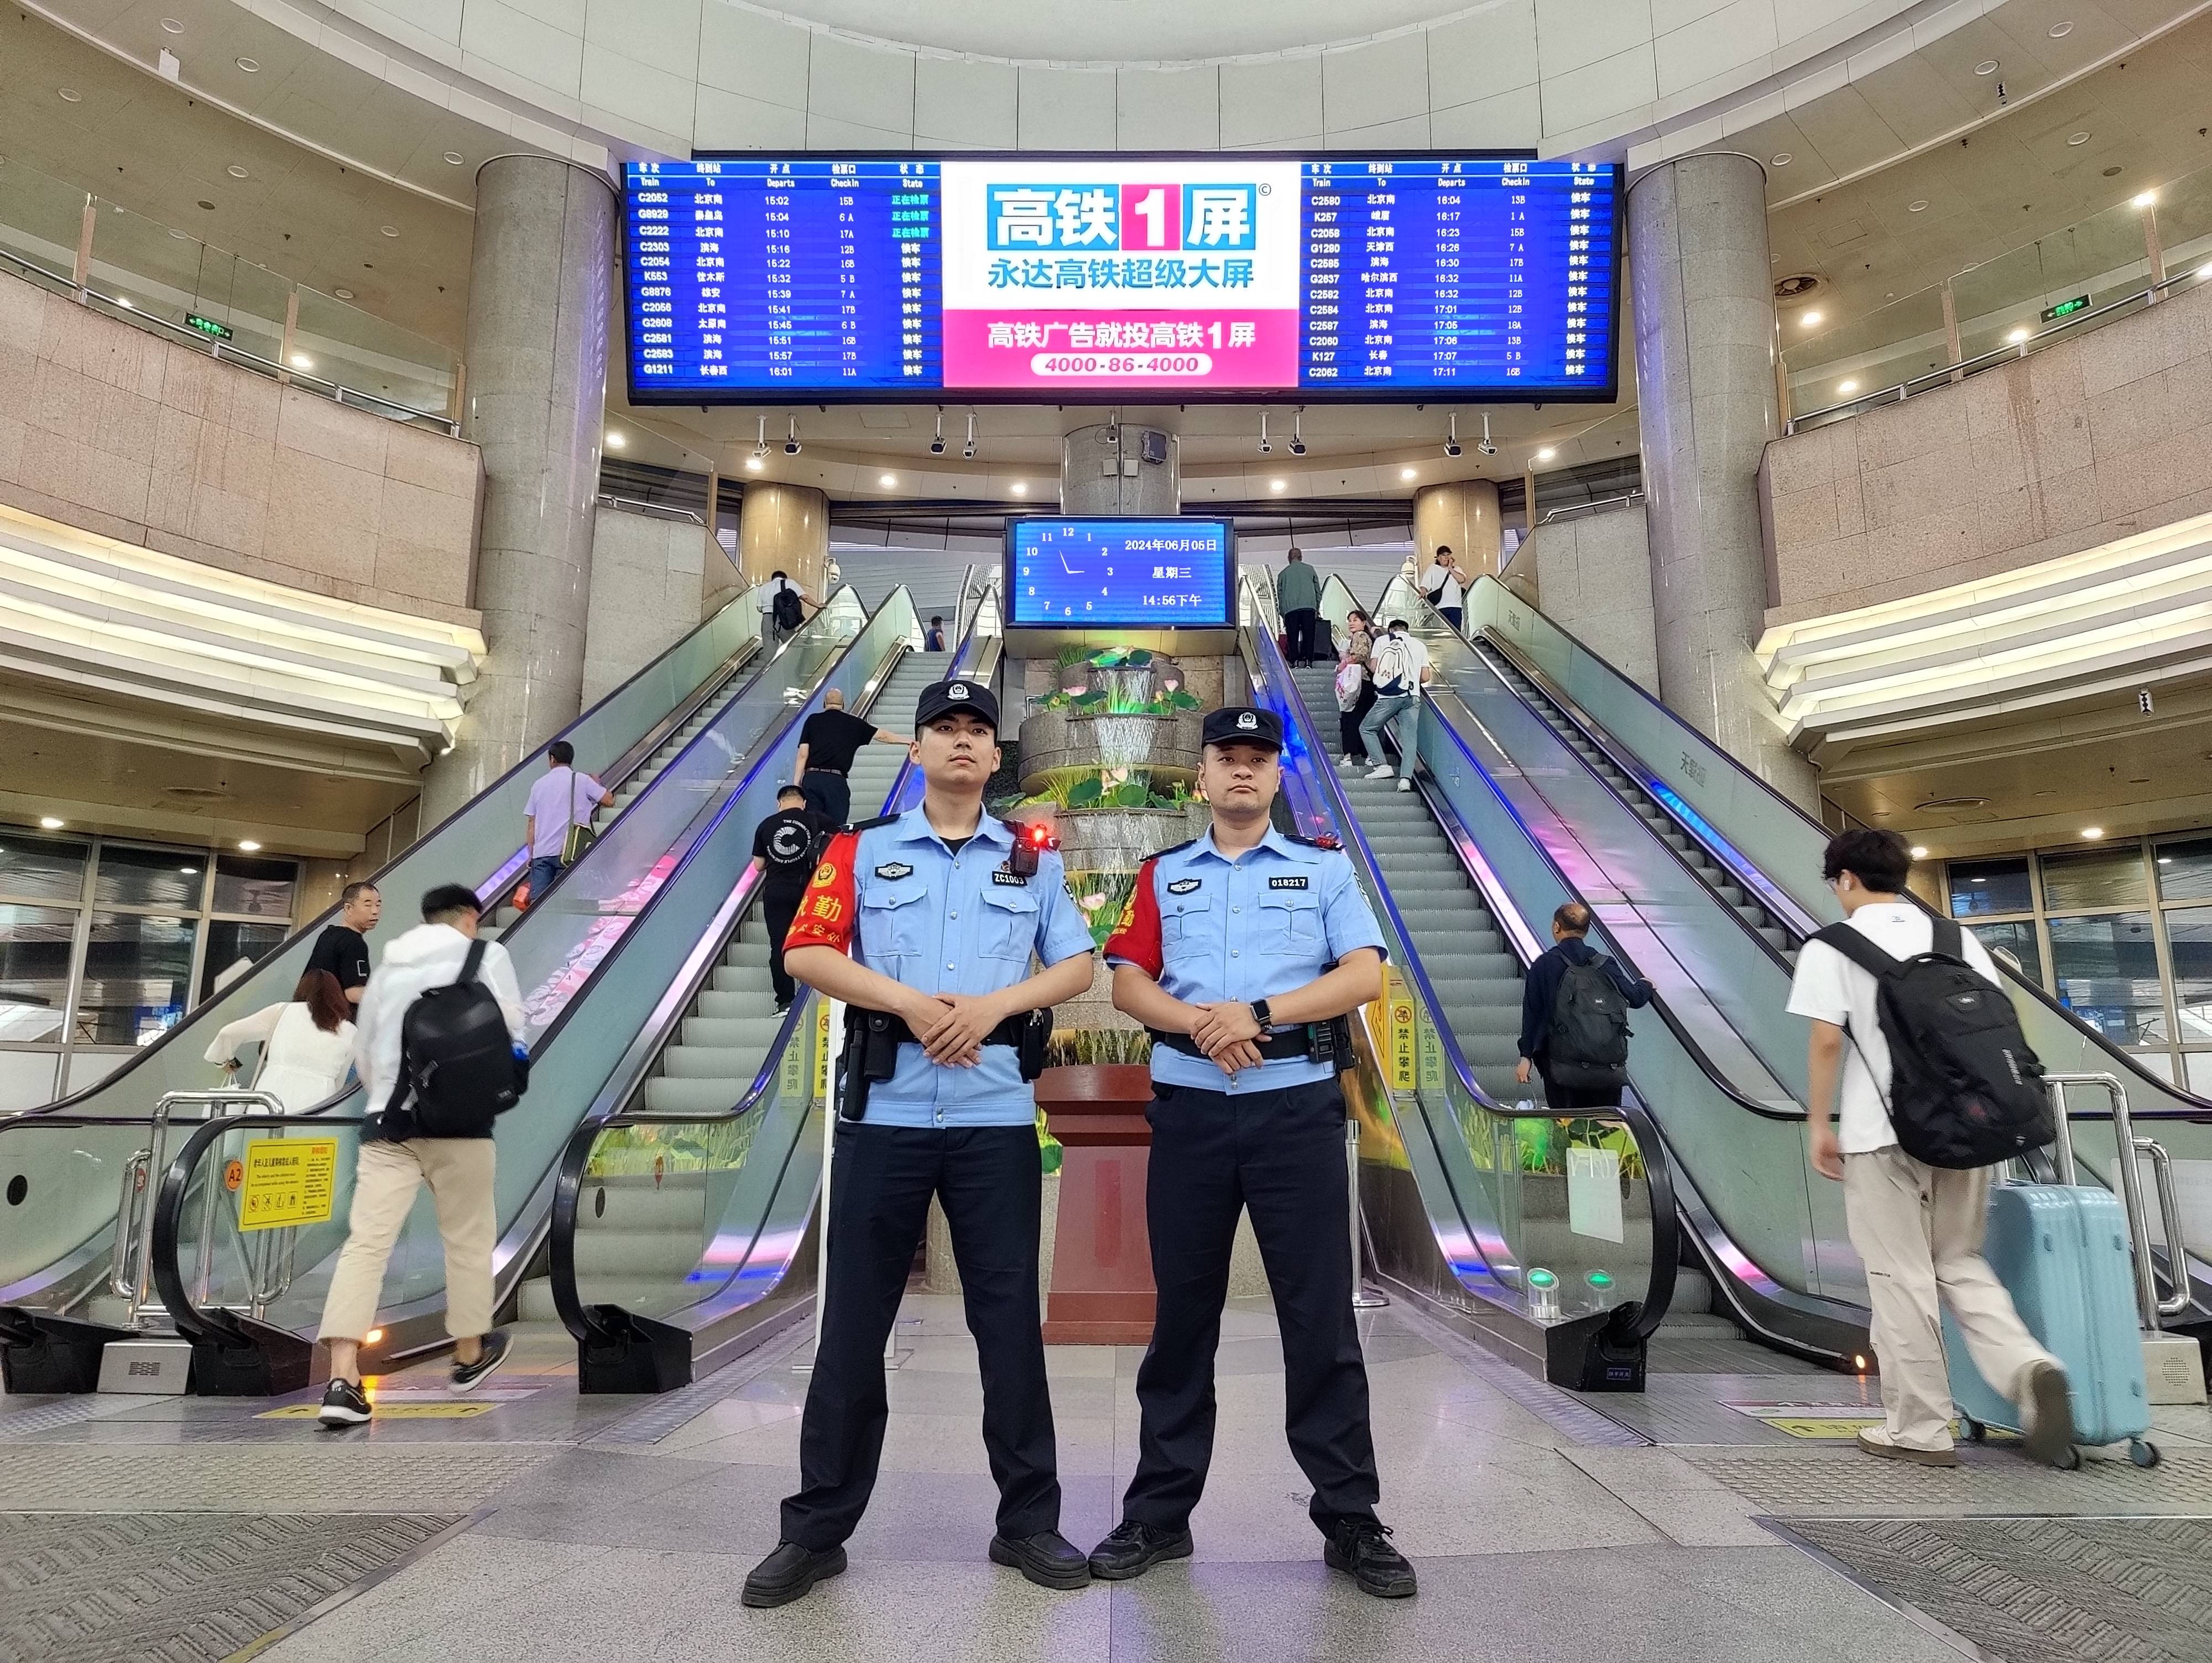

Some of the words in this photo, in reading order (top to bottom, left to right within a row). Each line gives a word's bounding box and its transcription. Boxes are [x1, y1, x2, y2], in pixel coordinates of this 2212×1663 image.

[697, 163, 721, 174] 终到站
[832, 164, 856, 174] 检票口
[1368, 163, 1393, 174] 终到站
[1504, 163, 1527, 173] 检票口
[640, 177, 659, 186] Train
[706, 177, 716, 186] To
[767, 179, 795, 188] Departs
[902, 179, 922, 188] State
[1312, 177, 1331, 187] Train
[1378, 177, 1386, 186] To
[1438, 177, 1465, 187] Departs
[1574, 176, 1594, 185] State
[638, 192, 668, 202] C2052
[694, 193, 723, 205] 北京南
[765, 196, 789, 205] 15:02
[839, 196, 854, 206] 15B
[891, 194, 929, 205] 正在检票
[1311, 196, 1340, 206] C2580
[1366, 194, 1395, 205] 北京南
[1437, 196, 1460, 205] 16:04
[1511, 195, 1526, 204] 13B
[765, 212, 789, 222] 15:04
[891, 210, 929, 222] 正在检票
[994, 188, 1250, 247] 高铁1屏
[1314, 212, 1337, 222] K257
[1437, 212, 1460, 221] 16:17
[639, 226, 669, 236] C2222
[695, 226, 723, 238] 北京南
[766, 229, 790, 238] 15:10
[840, 229, 854, 239] 17A
[892, 227, 930, 238] 正在检票
[1311, 228, 1340, 238] C2058
[1366, 226, 1395, 237] 北京南
[1436, 228, 1460, 237] 16:23
[1511, 228, 1525, 237] 15B
[640, 242, 670, 252] C2303
[700, 242, 719, 253] 滨海
[766, 244, 790, 254] 15:16
[841, 245, 854, 254] 12B
[1311, 243, 1340, 253] G1280
[1366, 241, 1395, 252] 天津西
[1436, 243, 1460, 252] 16:26
[640, 257, 670, 266] C2054
[696, 256, 724, 268] 北京南
[766, 259, 790, 268] 15:22
[841, 259, 855, 268] 16B
[1310, 258, 1339, 269] C2585
[1370, 256, 1389, 267] 滨海
[1436, 258, 1459, 267] 16:30
[1510, 258, 1524, 267] 17B
[644, 271, 668, 281] K553
[697, 271, 725, 283] 佳木斯
[767, 274, 791, 283] 15:32
[988, 258, 1254, 289] 永达高铁超级大屏
[1361, 272, 1399, 283] 哈尔滨西
[1435, 274, 1459, 283] 16:32
[1510, 274, 1523, 283] 11A
[641, 287, 671, 296] G8876
[701, 287, 721, 298] 雄安
[768, 290, 791, 299] 15:39
[1310, 290, 1339, 299] C2582
[1365, 287, 1394, 299] 北京南
[1434, 289, 1459, 298] 16:32
[1509, 289, 1523, 298] 12B
[698, 302, 726, 313] 北京南
[768, 305, 790, 314] 15:41
[842, 305, 855, 314] 17B
[1310, 305, 1339, 315] C2584
[1365, 303, 1393, 314] 北京南
[1434, 305, 1457, 313] 17:01
[1509, 305, 1522, 313] 12B
[642, 318, 672, 327] G2608
[698, 318, 726, 329] 太原南
[768, 320, 792, 330] 15:45
[1310, 321, 1339, 331] C2587
[1369, 319, 1388, 330] 滨海
[1434, 321, 1458, 330] 17:05
[1508, 321, 1522, 330] 18A
[643, 333, 671, 343] C2581
[703, 333, 722, 344] 滨海
[769, 336, 791, 345] 15:51
[842, 336, 856, 345] 16B
[987, 321, 1256, 349] 高铁广告就投高铁1屏
[1309, 336, 1338, 346] C2060
[1364, 334, 1392, 345] 北京南
[1507, 336, 1521, 345] 13B
[643, 348, 674, 359] C2583
[703, 349, 722, 360] 滨海
[769, 351, 792, 360] 15:57
[843, 352, 857, 360] 17B
[1312, 352, 1335, 362] K127
[1369, 349, 1387, 360] 长春
[1433, 352, 1457, 360] 17:07
[643, 364, 672, 374] G1211
[700, 364, 728, 376] 长春西
[769, 367, 792, 376] 16:01
[843, 368, 857, 376] 11A
[1045, 358, 1198, 373] 4000-86-4000
[1309, 368, 1338, 377] C2062
[1364, 365, 1392, 376] 北京南
[1433, 367, 1455, 376] 17:11
[1506, 367, 1521, 376] 16B
[1042, 533, 1052, 541] 11
[1063, 528, 1074, 536] 12
[1087, 533, 1092, 541] 1
[1125, 538, 1217, 551] 2024年06月05日
[1027, 547, 1037, 556] 10
[1102, 547, 1108, 556] 2
[1023, 567, 1029, 576] 9
[1107, 567, 1113, 576] 3
[1152, 566, 1192, 579] 星期三
[1029, 587, 1035, 595] 8
[1102, 587, 1108, 595] 4
[1045, 602, 1050, 610] 7
[1086, 602, 1092, 610] 5
[1142, 594, 1202, 607] 14:56下午
[1065, 607, 1071, 615] 6
[994, 874, 1024, 884] ZC1003
[1271, 878, 1306, 887] 018217
[1399, 1028, 1410, 1081] 禁止攀爬
[229, 1168, 241, 1182] A2
